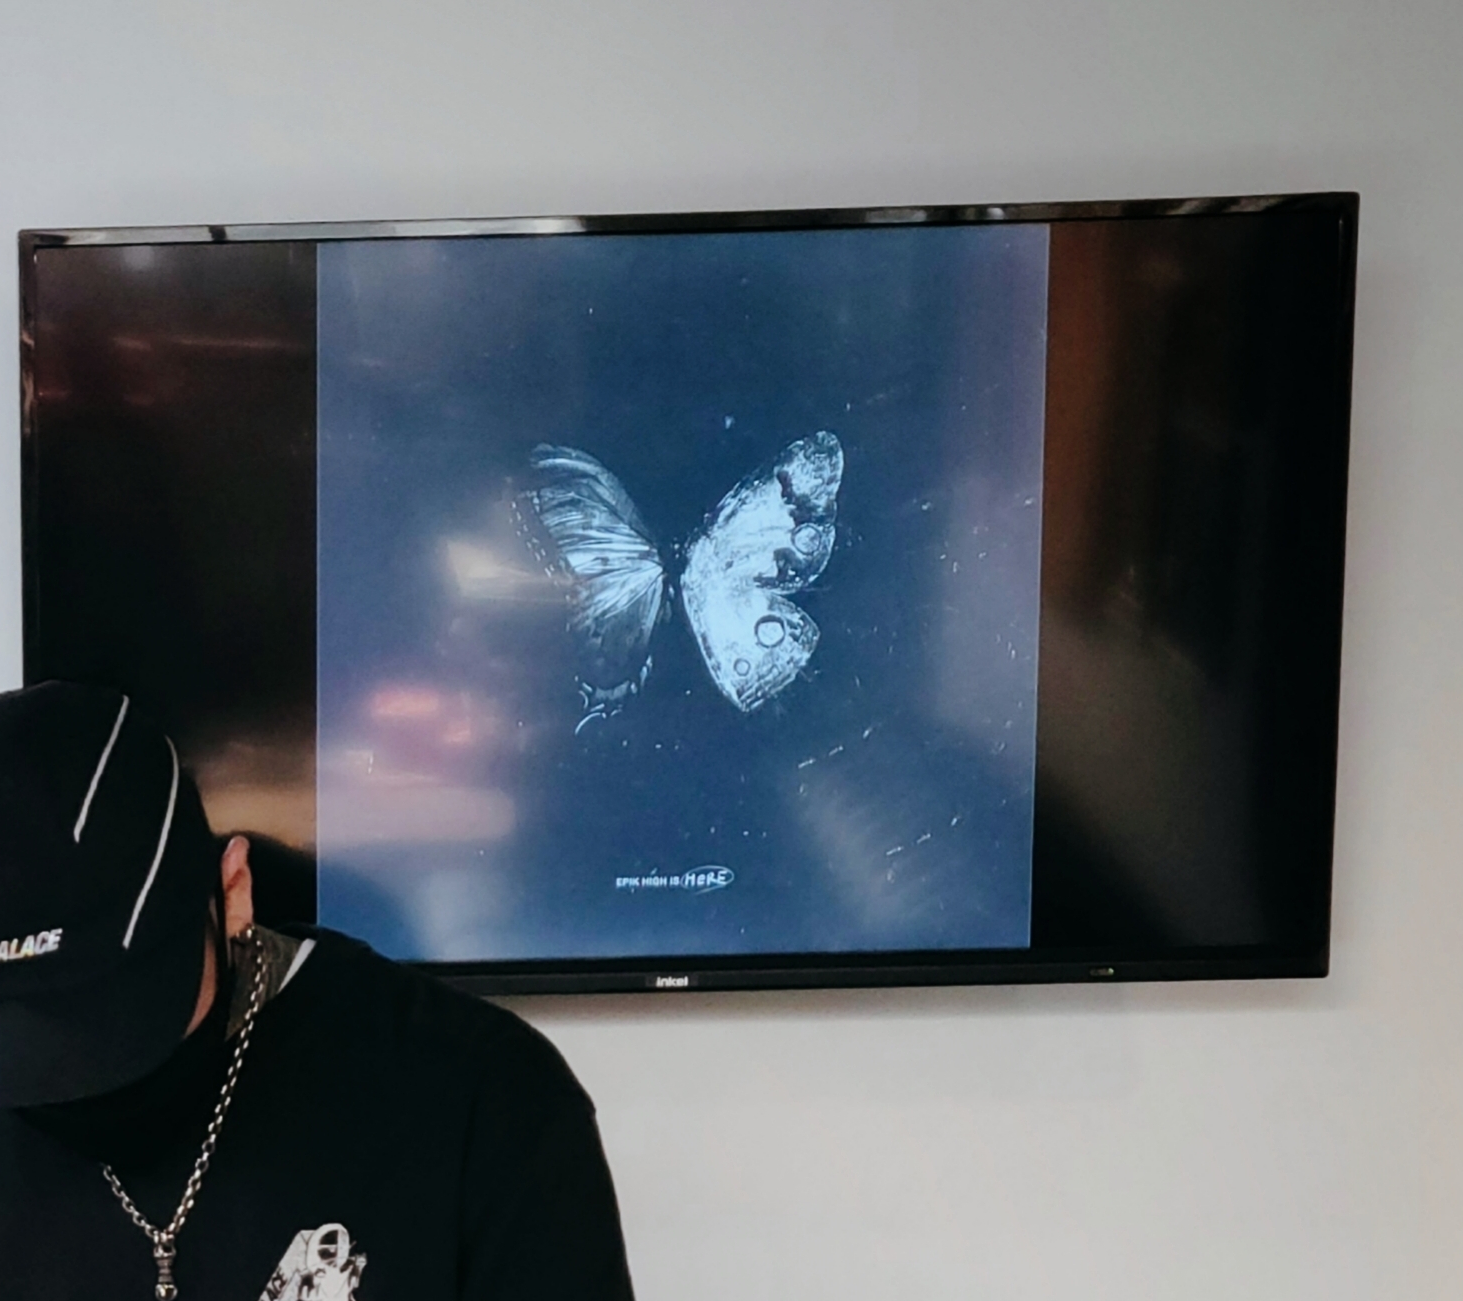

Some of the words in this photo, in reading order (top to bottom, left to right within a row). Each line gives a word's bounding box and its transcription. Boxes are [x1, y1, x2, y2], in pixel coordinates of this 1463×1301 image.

[615, 876, 640, 888] EPIK
[641, 875, 667, 887] HIGH
[669, 876, 680, 886] IS
[655, 976, 690, 988] inkel
